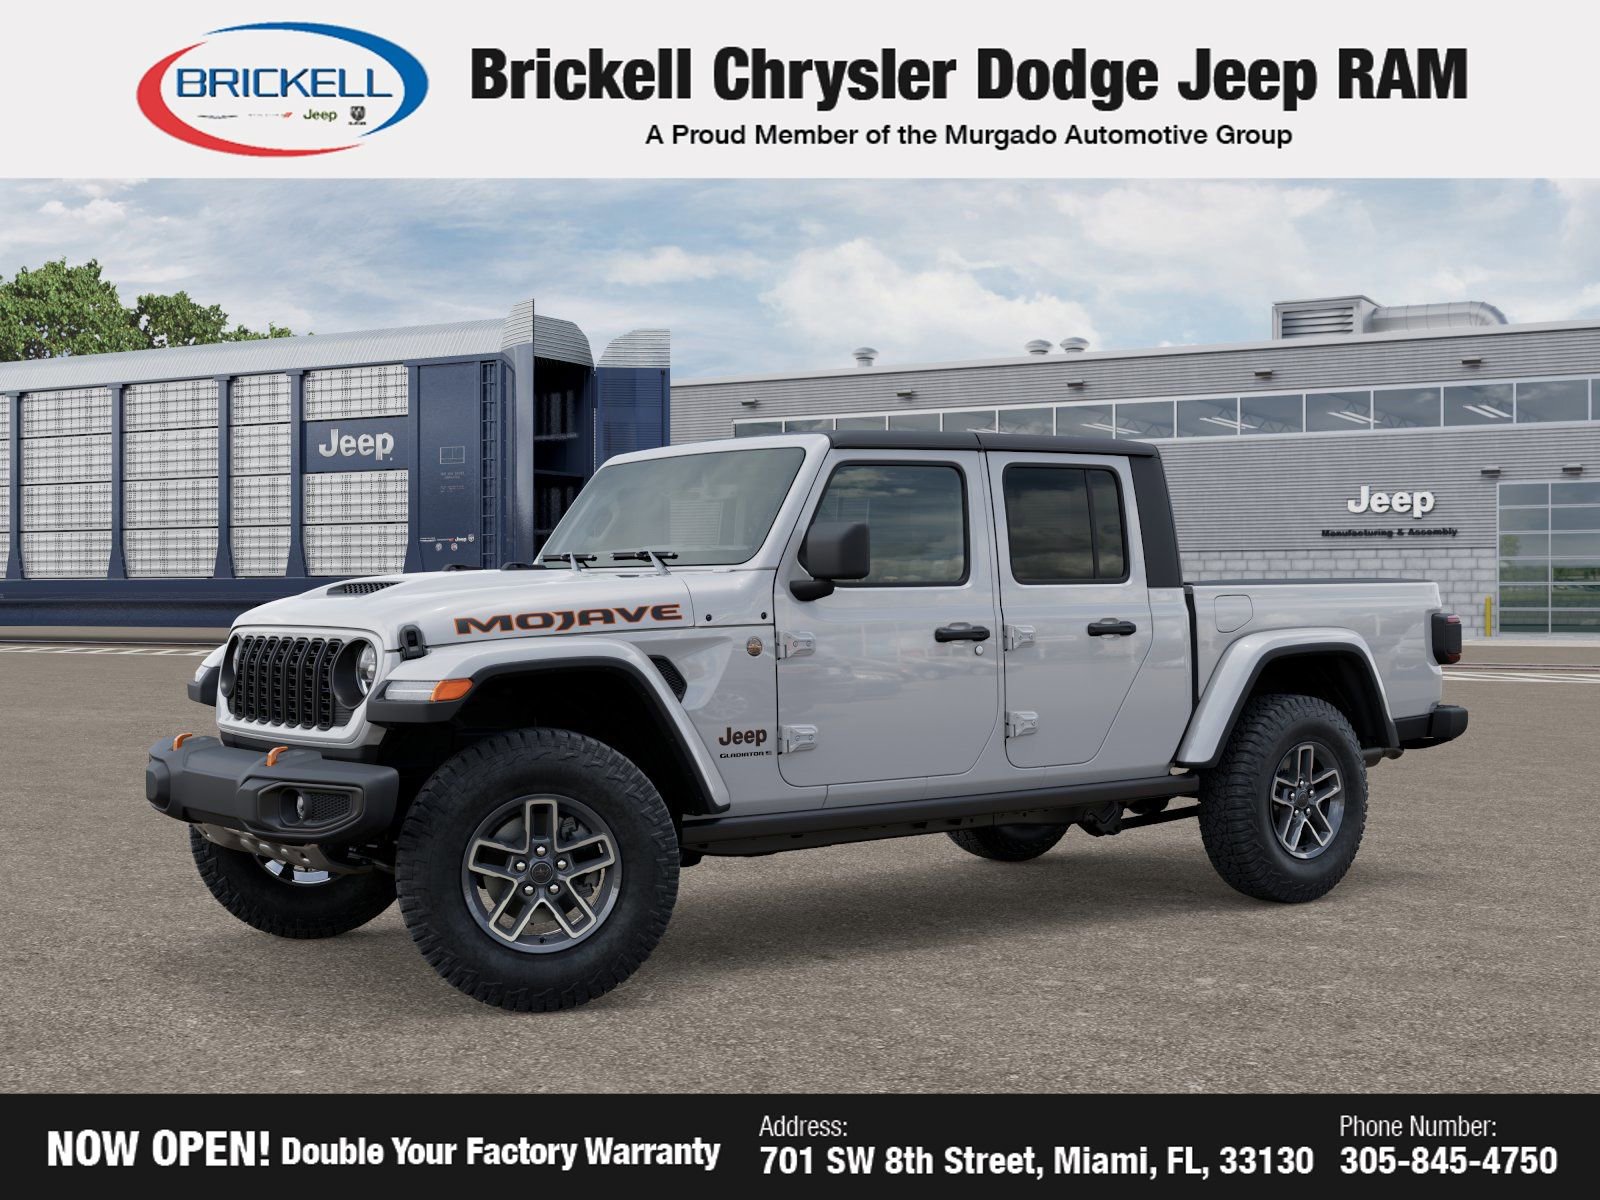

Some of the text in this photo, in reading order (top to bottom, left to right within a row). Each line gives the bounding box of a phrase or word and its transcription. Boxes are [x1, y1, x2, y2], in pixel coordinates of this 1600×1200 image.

[318, 428, 395, 461] Jeep
[1347, 485, 1436, 520] Jeep
[1321, 527, 1458, 539] Manufacturing & Assembly
[454, 603, 683, 635] MOJAVE
[718, 727, 768, 747] Jeep
[719, 751, 764, 759] GLADIATOR
